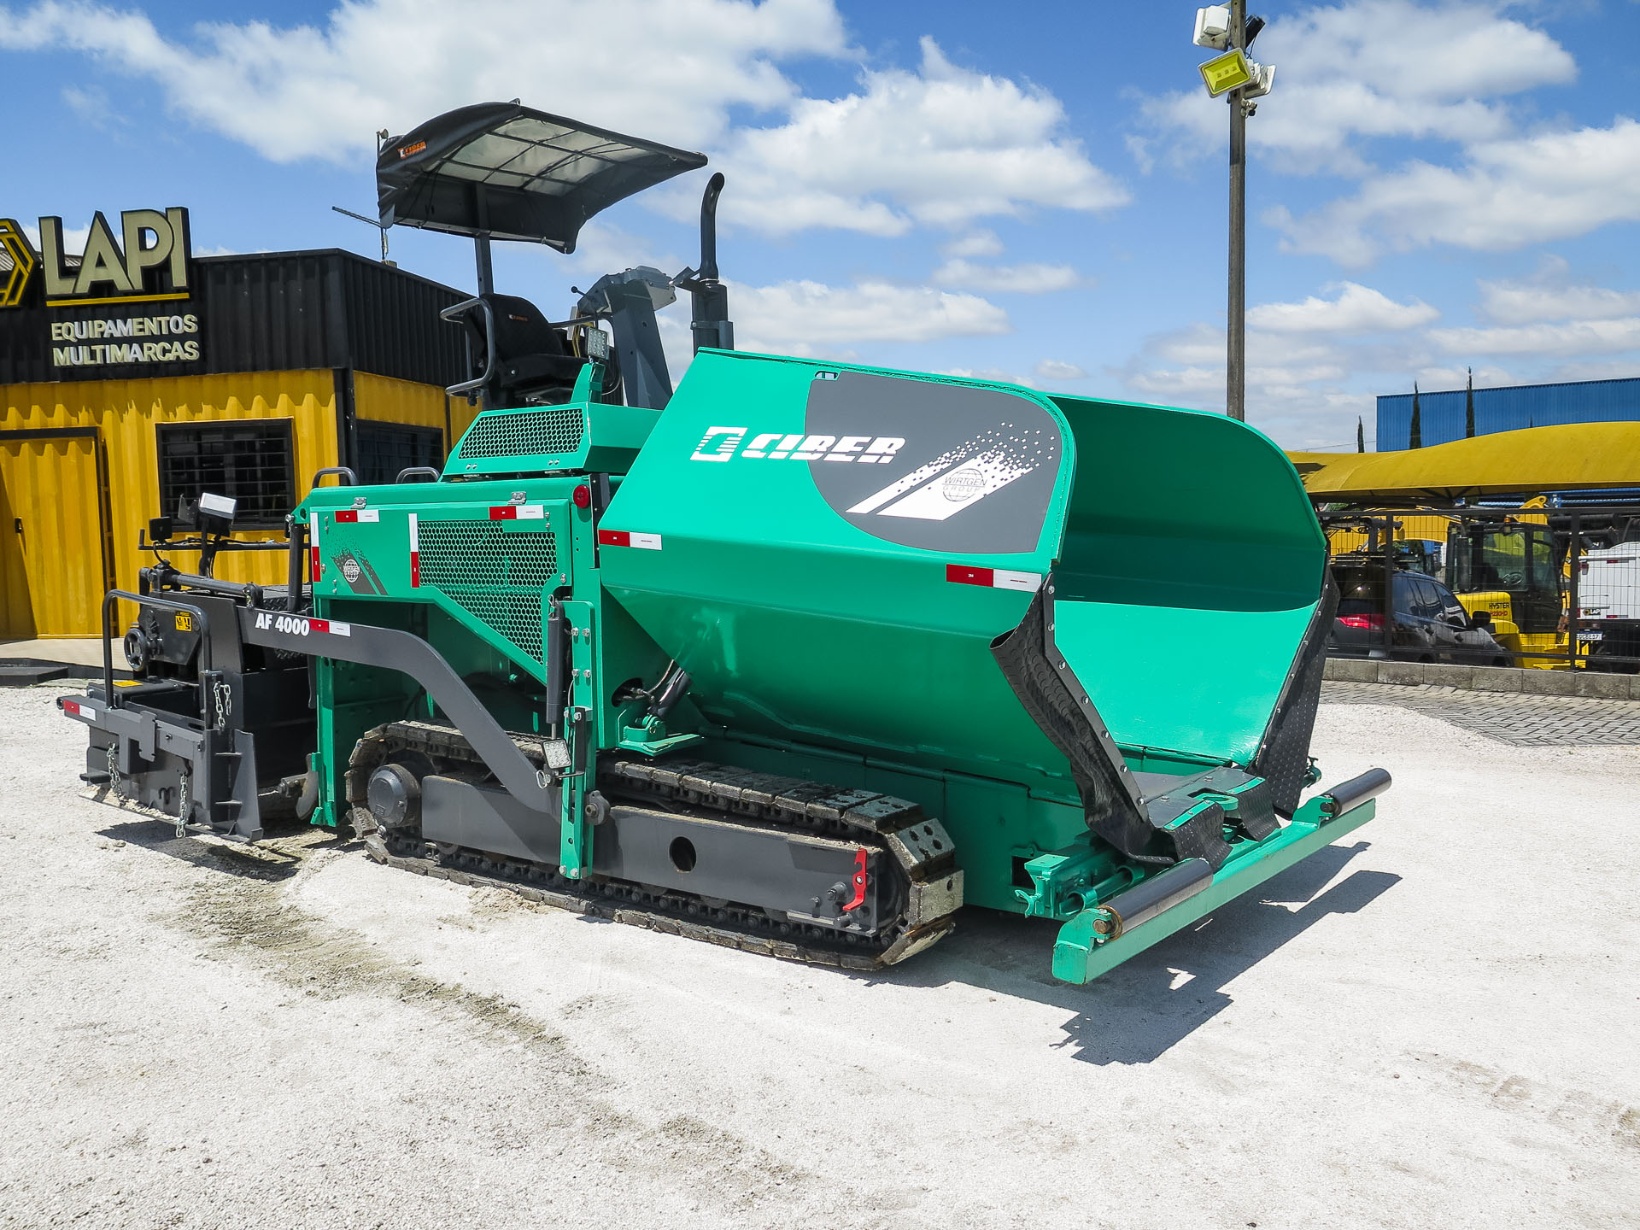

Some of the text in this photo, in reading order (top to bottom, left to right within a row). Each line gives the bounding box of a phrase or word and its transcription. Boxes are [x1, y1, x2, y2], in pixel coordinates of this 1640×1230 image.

[39, 207, 189, 296] LAPI
[51, 314, 198, 341] EQUIPAMENTOS
[53, 341, 199, 366] MULTIMARCAS
[741, 433, 906, 464] CIBER
[945, 476, 988, 486] WIRTGEN
[255, 612, 310, 637] AF 4000
